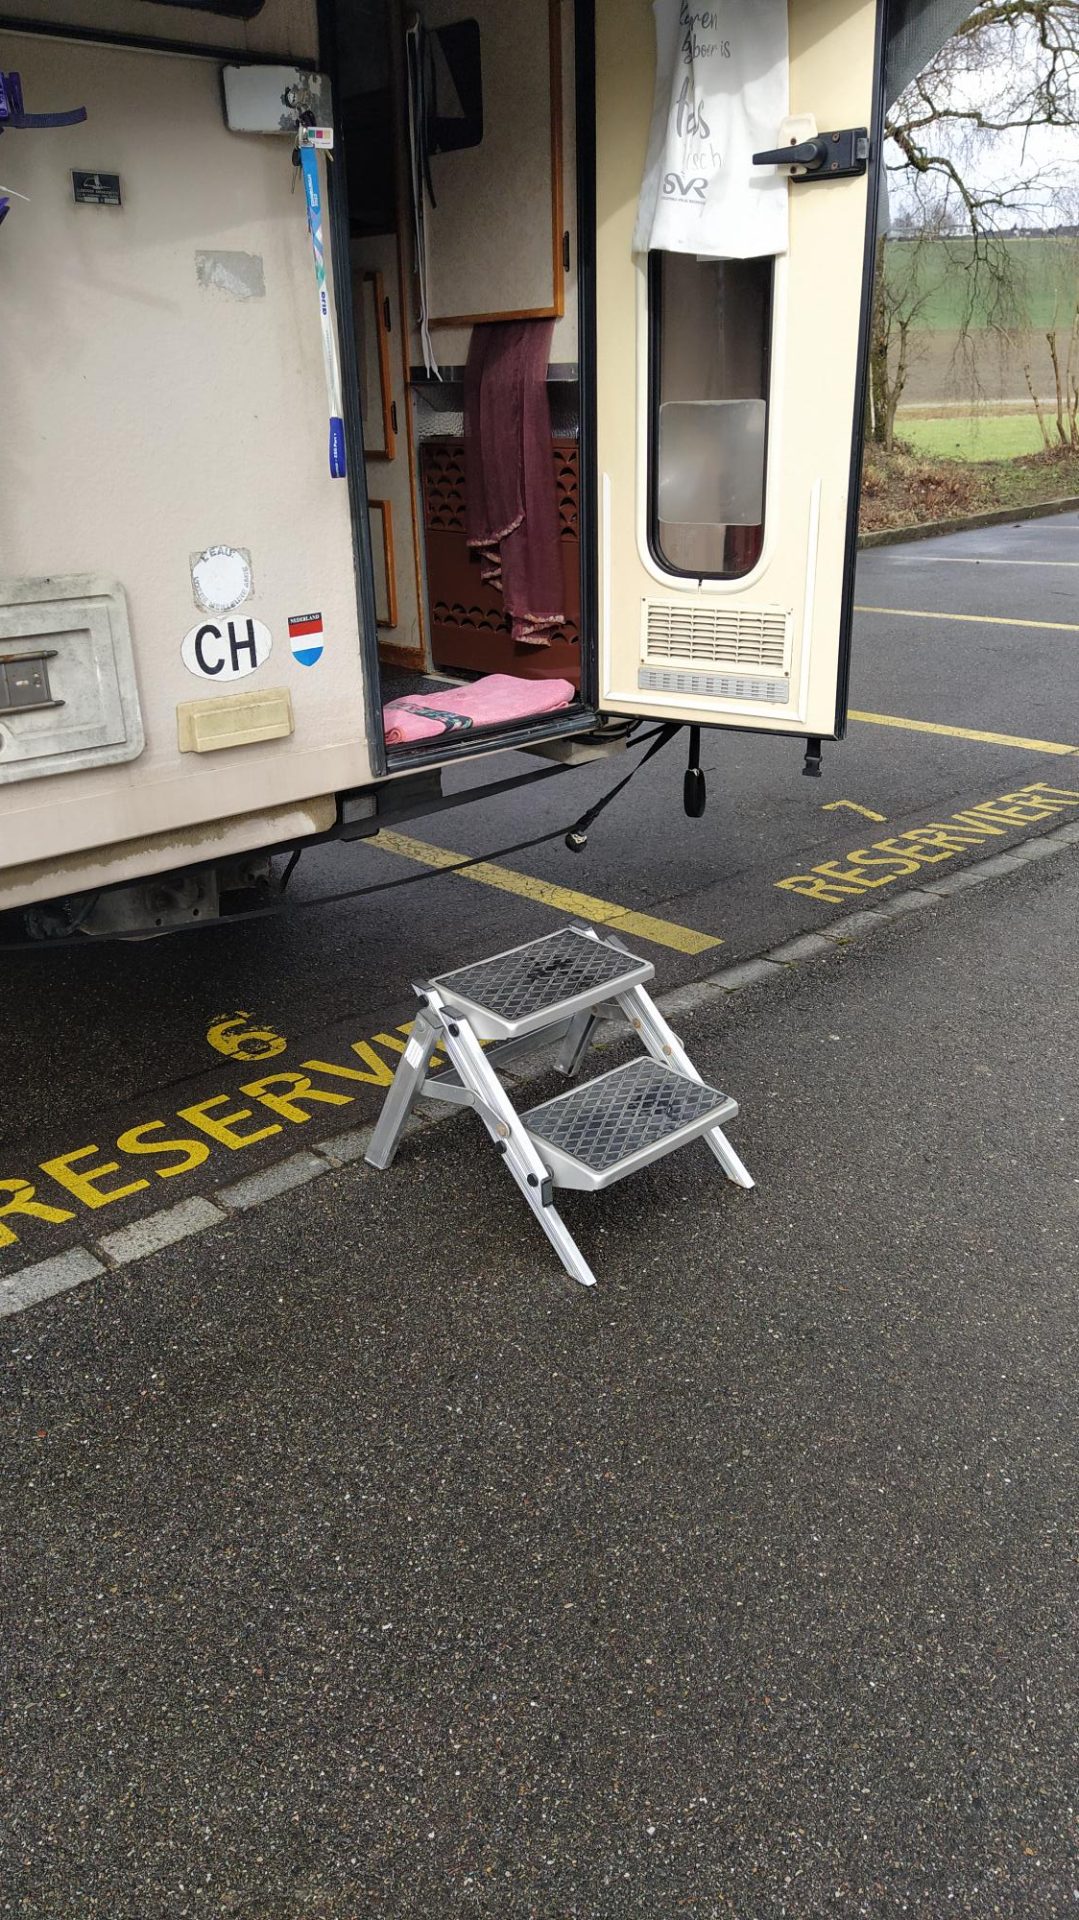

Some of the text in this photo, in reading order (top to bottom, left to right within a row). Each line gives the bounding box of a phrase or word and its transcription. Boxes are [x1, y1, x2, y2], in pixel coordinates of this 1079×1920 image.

[195, 618, 258, 676] CH
[822, 799, 888, 823] 7
[773, 782, 1079, 904] RESERVIERT
[205, 1010, 288, 1062] 6
